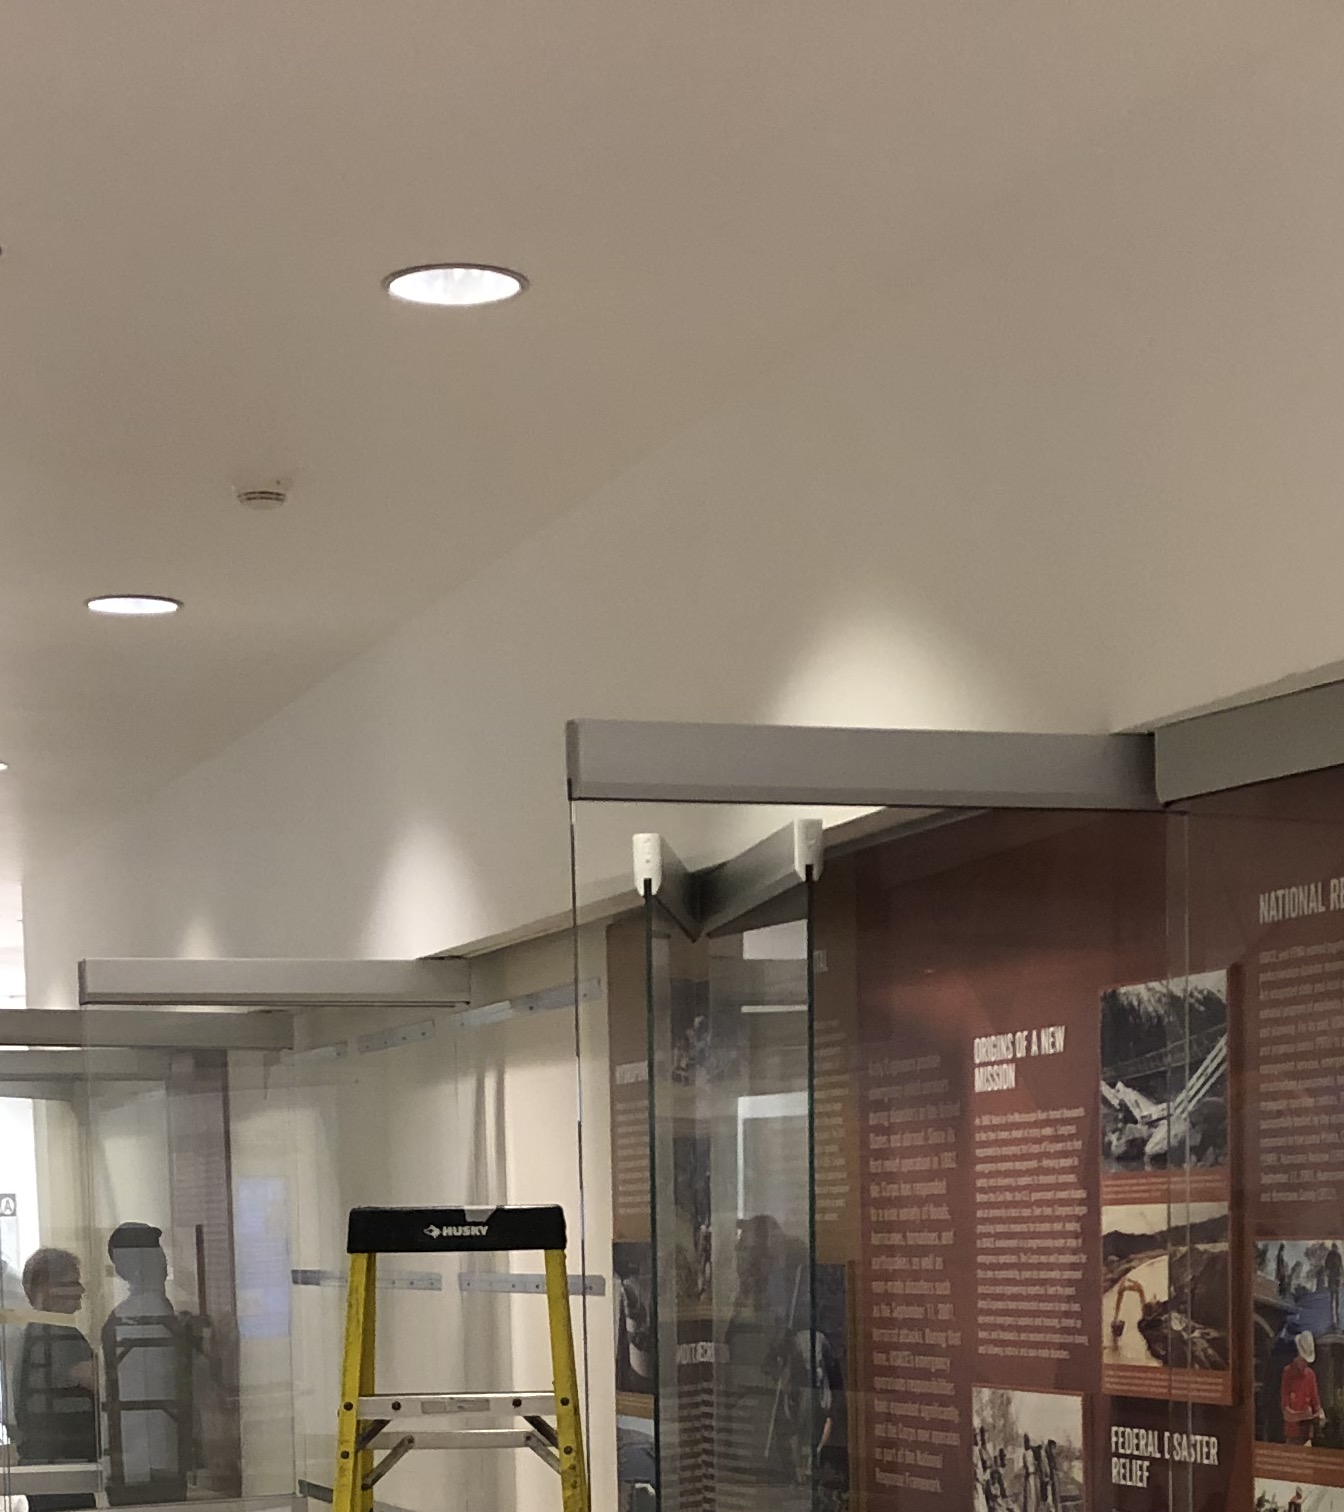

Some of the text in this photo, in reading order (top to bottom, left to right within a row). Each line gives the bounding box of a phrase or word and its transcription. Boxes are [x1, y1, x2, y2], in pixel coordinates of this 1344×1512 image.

[1260, 881, 1326, 924] NATIONAL
[974, 1025, 1065, 1064] ORIGINS OF A NEW
[974, 1063, 1016, 1093] MISSION
[442, 1226, 488, 1237] HUSKY
[1111, 1426, 1219, 1466] FEDERAL DSASTER
[1111, 1457, 1149, 1488] RELIEF
